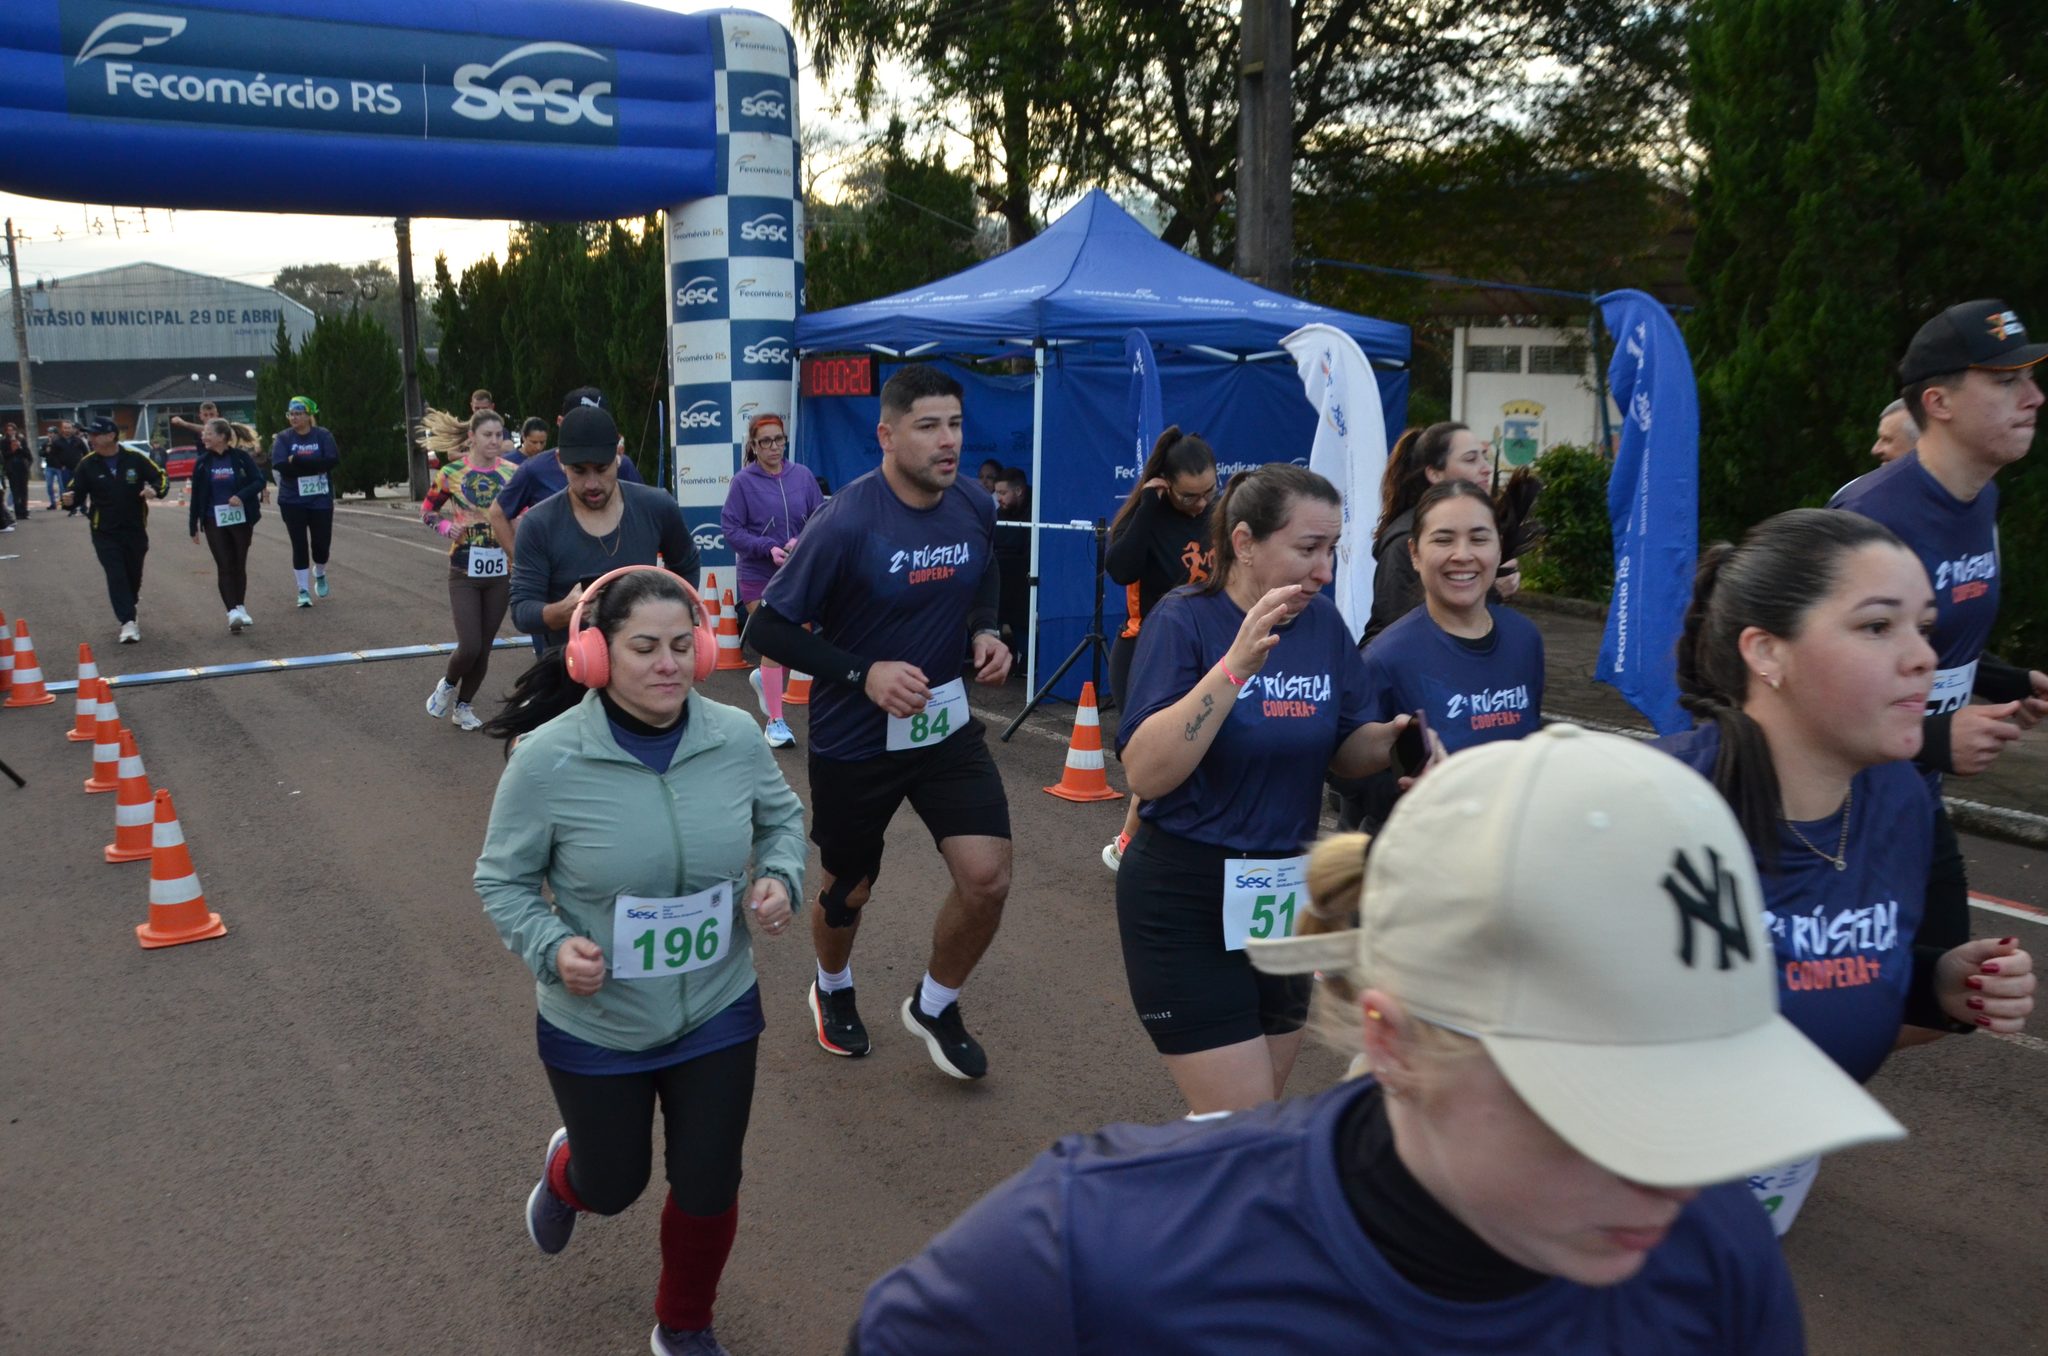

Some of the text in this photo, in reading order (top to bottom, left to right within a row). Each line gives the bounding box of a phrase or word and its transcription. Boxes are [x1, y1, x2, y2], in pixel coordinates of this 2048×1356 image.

[106, 61, 402, 115] Fecomércio RS
[452, 60, 614, 127] Sesc
[741, 96, 786, 120] Sesc
[740, 221, 787, 242] Sesc
[676, 287, 718, 306] Sesc
[739, 289, 784, 299] Fecomércio
[91, 310, 184, 326] MUNICIPAL
[190, 310, 211, 324] 29
[215, 310, 236, 324] DE
[743, 344, 790, 364] Sesc
[680, 410, 721, 428] Sesc
[220, 511, 242, 524] 240
[692, 533, 725, 550] esc
[912, 542, 970, 569] RÚSTICA
[474, 558, 504, 574] 905
[908, 566, 957, 585] COOPERA+
[1614, 581, 1629, 673] Fecomércio
[1263, 671, 1332, 701] RÚSTICA
[1262, 700, 1318, 717] COOPERA+
[1470, 684, 1530, 714] RÚSTICA
[909, 707, 950, 743] 84
[1235, 873, 1273, 889] Sesc
[627, 907, 659, 920] Sesc
[1791, 900, 1899, 960] RÚSTICA
[633, 917, 719, 971] 196
[1785, 955, 1882, 991] COOPERA+
